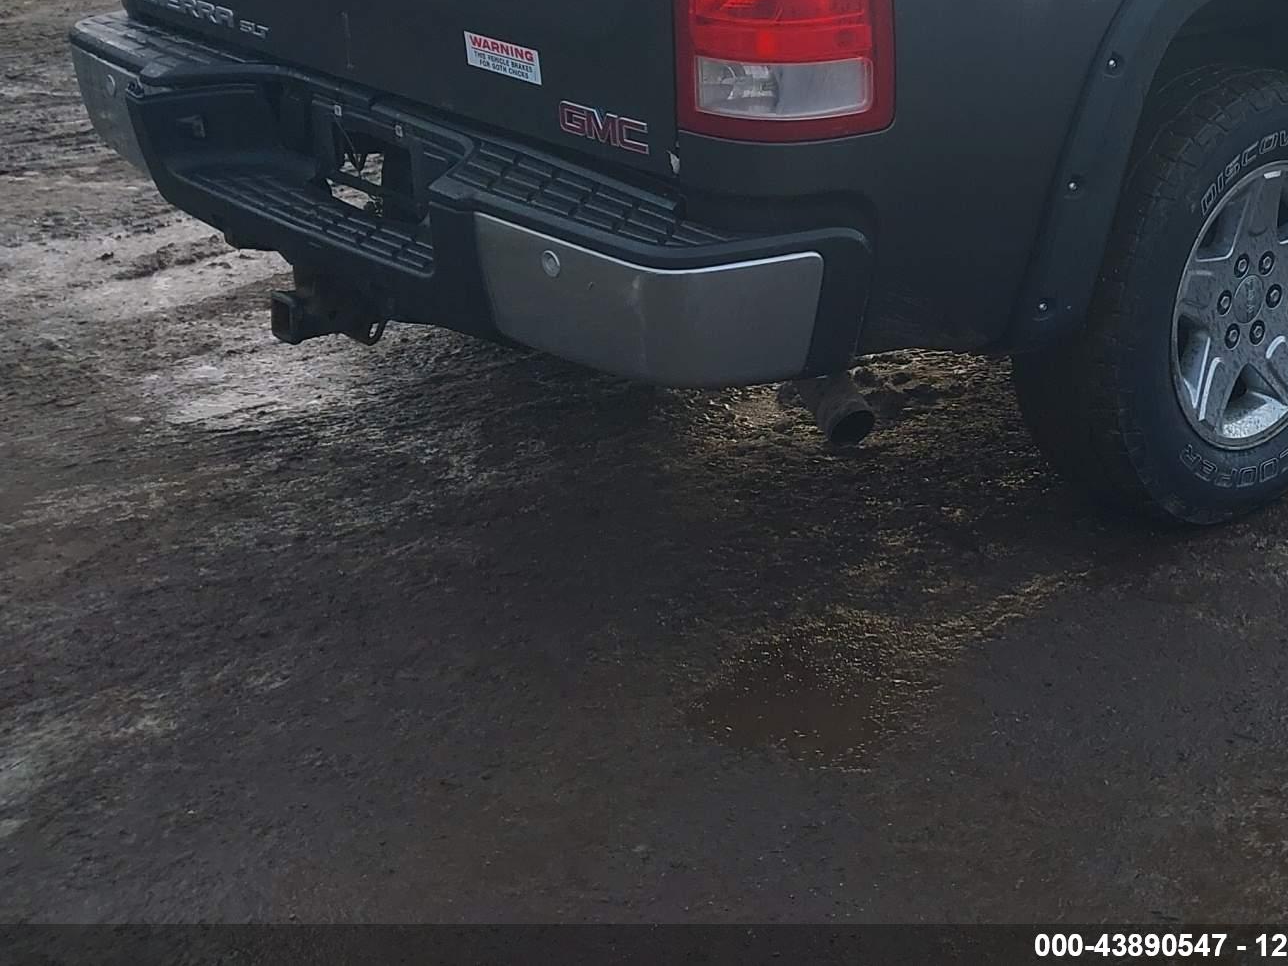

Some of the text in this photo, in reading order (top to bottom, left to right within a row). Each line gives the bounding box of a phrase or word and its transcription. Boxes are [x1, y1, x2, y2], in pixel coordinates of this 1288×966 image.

[240, 19, 269, 38] SLT
[470, 34, 535, 62] WARNING
[480, 59, 491, 69] FOR
[488, 54, 510, 67] VEHICLE
[511, 61, 534, 74] BRAKES
[559, 100, 650, 154] GMC
